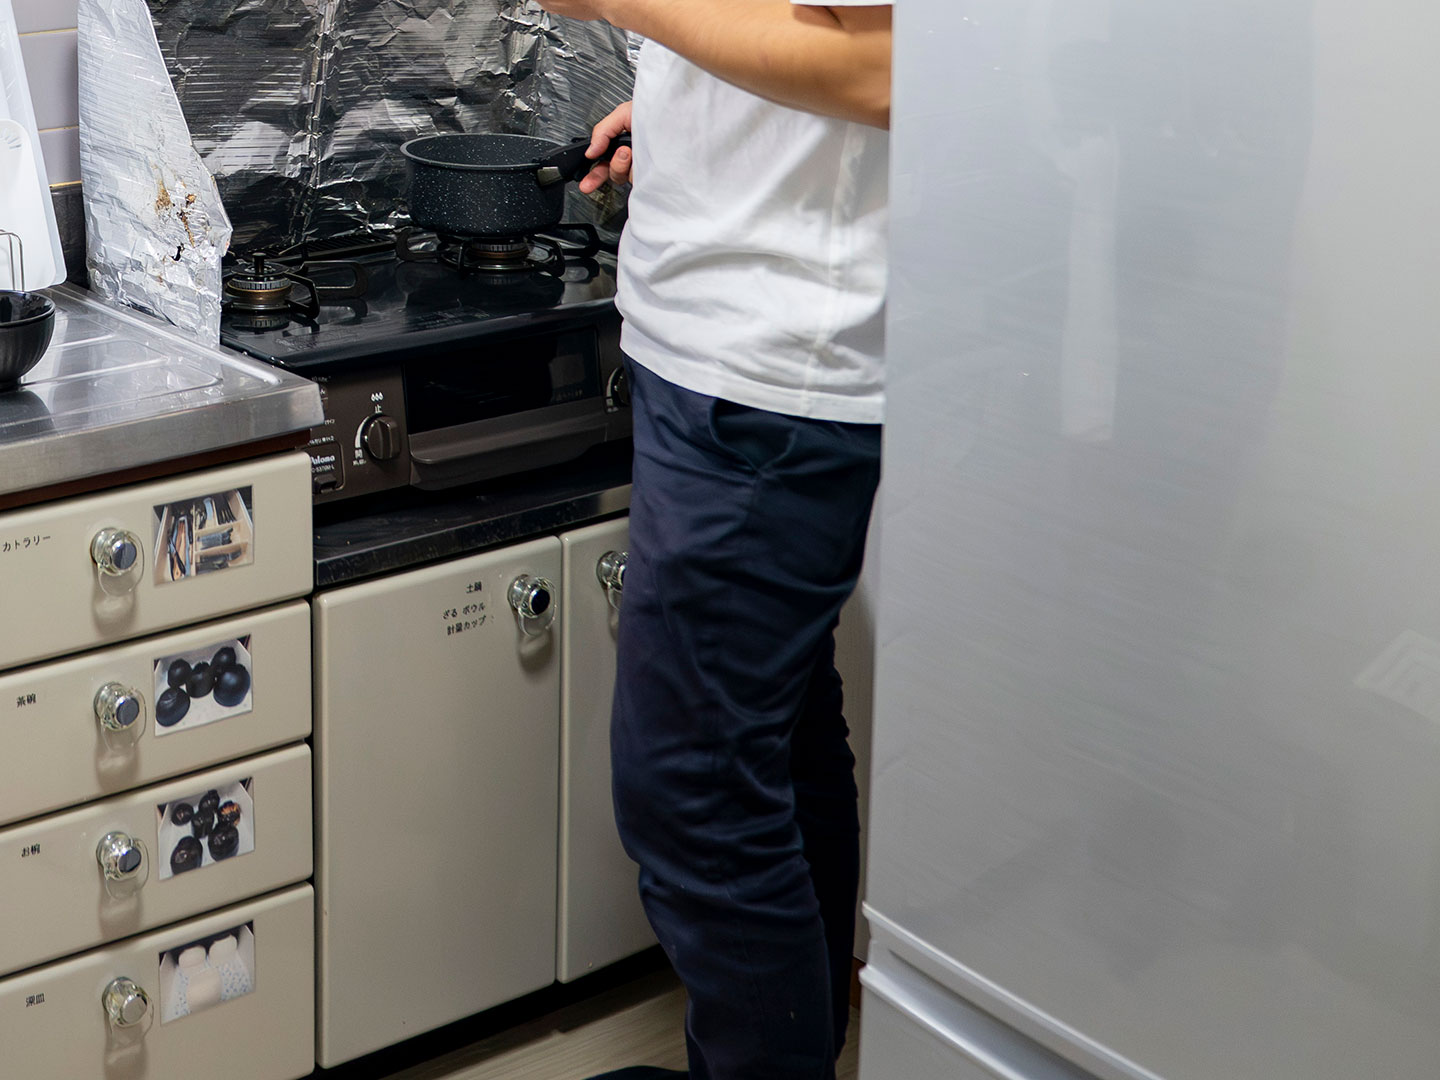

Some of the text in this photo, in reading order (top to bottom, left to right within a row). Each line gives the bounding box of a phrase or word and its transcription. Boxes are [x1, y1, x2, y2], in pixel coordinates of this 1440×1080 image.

[2, 536, 51, 552] カトラリー
[466, 581, 482, 594] 土鍋
[442, 602, 486, 620] ざる ボウル
[447, 614, 487, 636] 計量カップ
[16, 693, 36, 708] 茶碗
[21, 843, 40, 858] お椀
[25, 992, 45, 1007] 深皿
